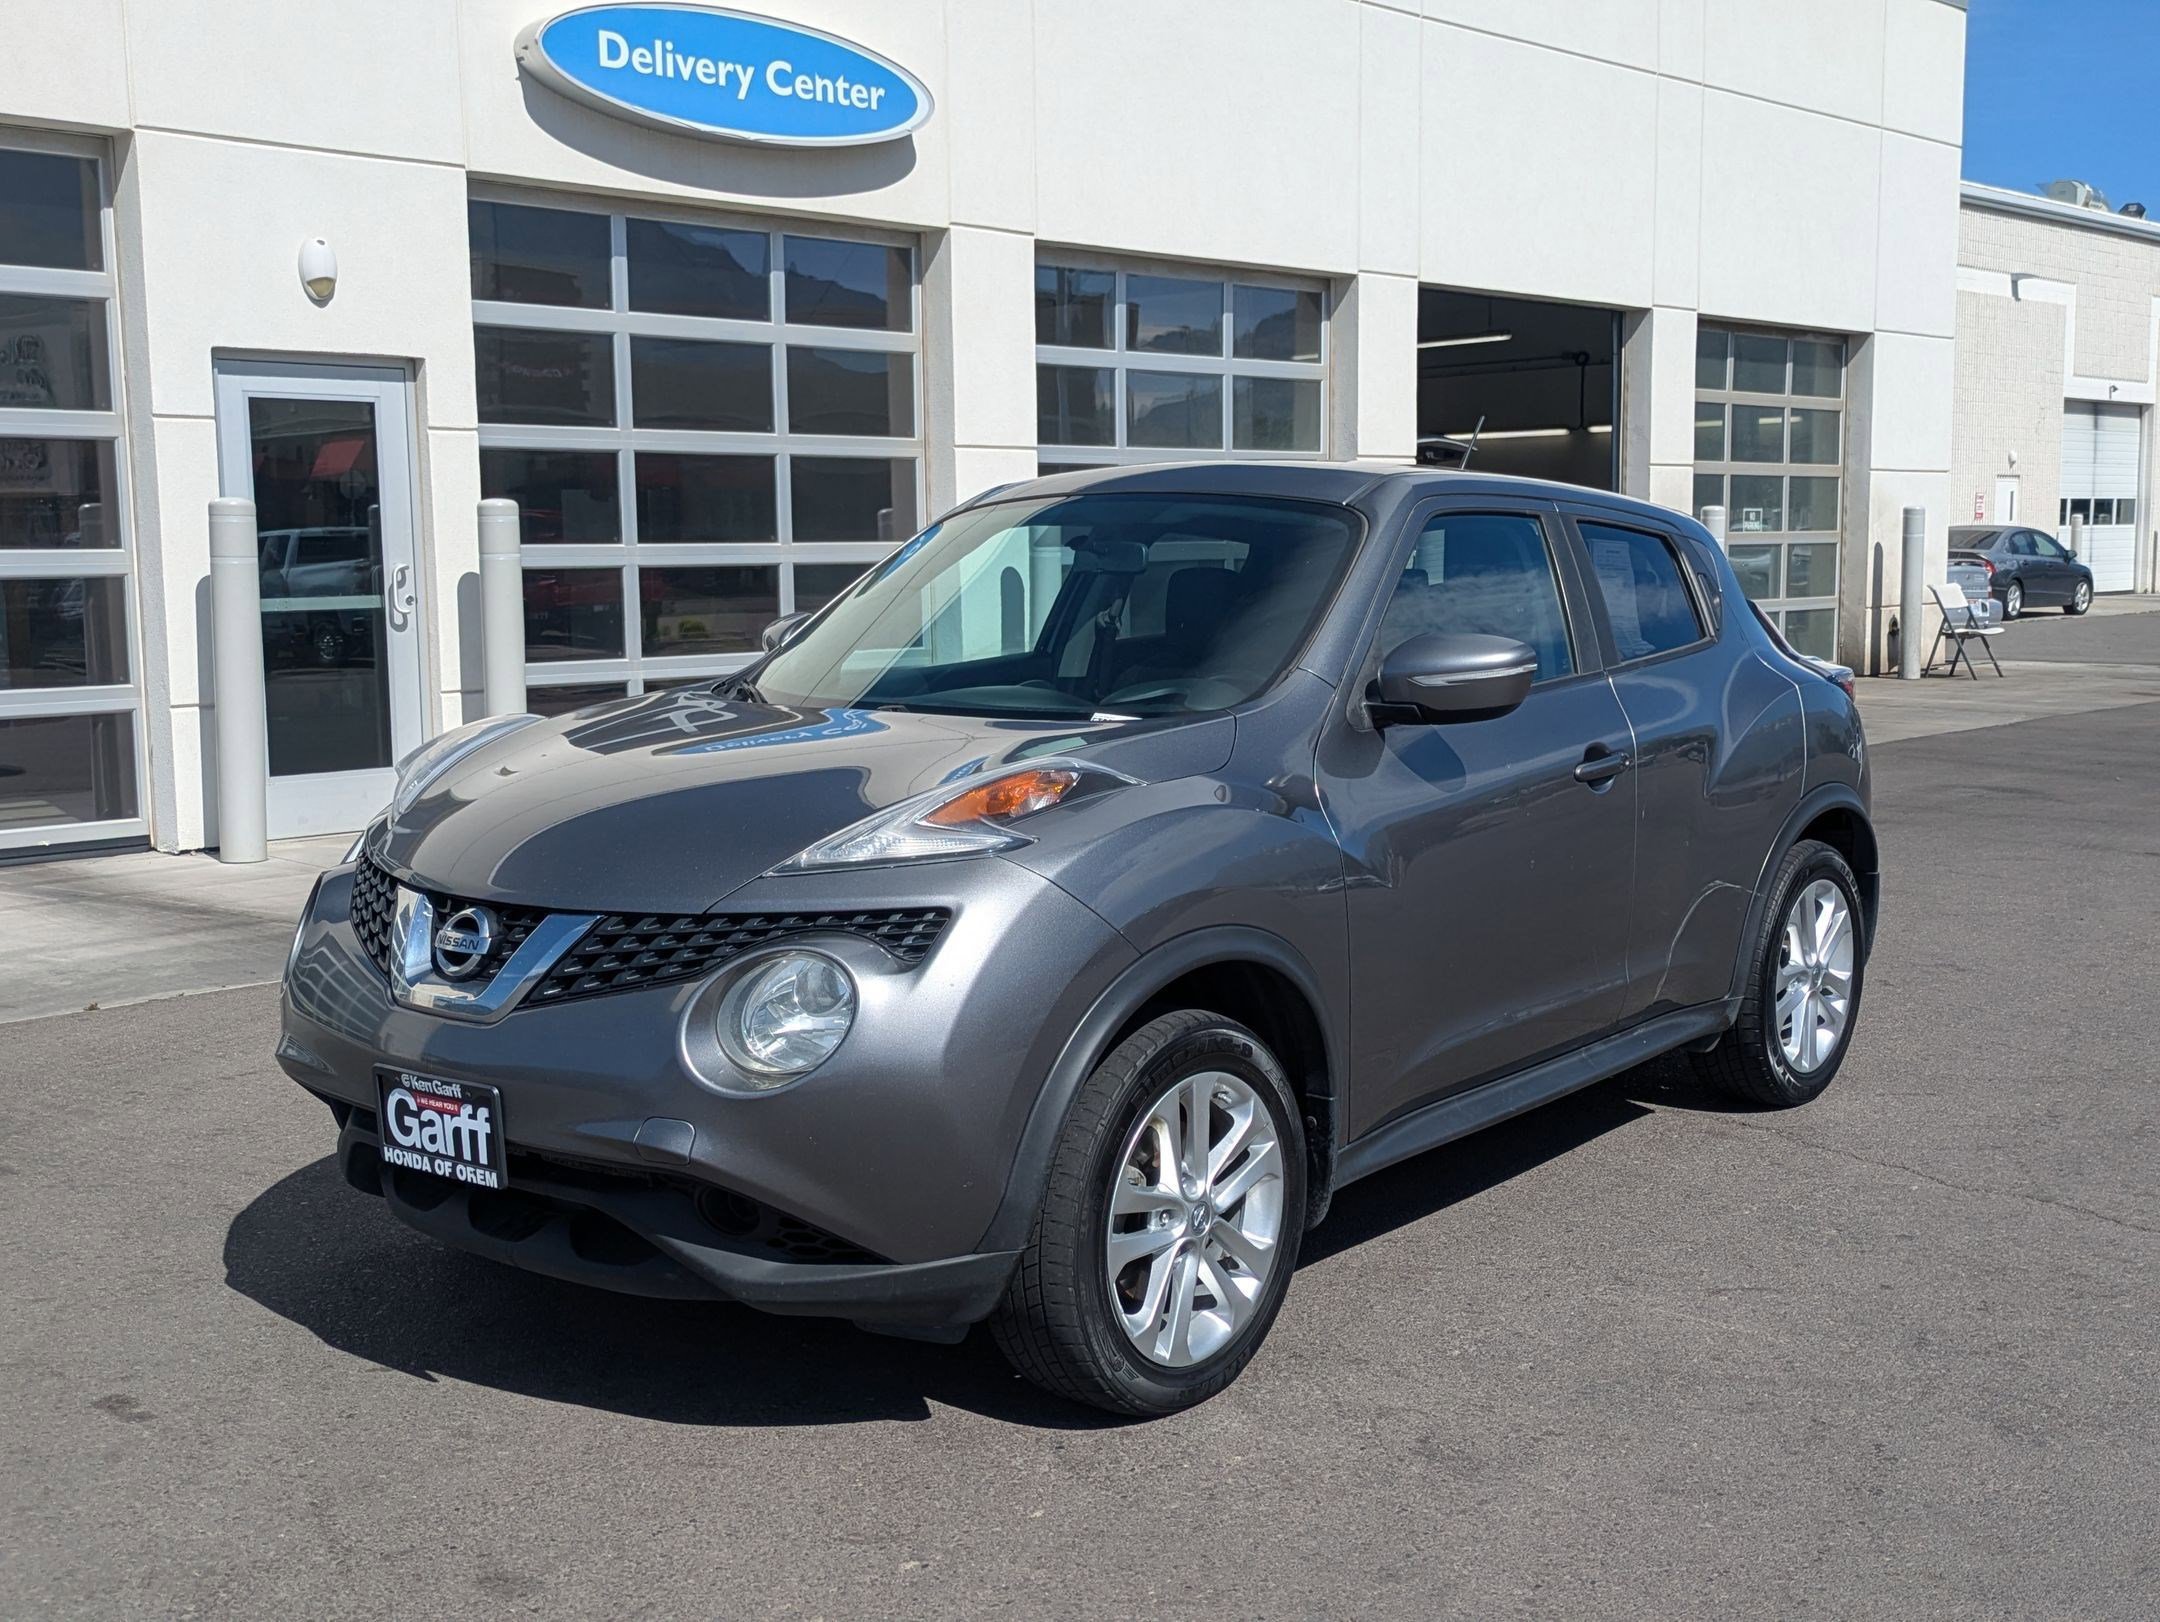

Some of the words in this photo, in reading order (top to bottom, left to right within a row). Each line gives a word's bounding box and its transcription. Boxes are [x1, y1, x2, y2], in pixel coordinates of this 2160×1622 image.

[598, 29, 755, 100] Delivery
[765, 60, 886, 111] Center
[438, 933, 480, 950] NISSAN
[410, 1075, 433, 1093] Ken
[432, 1080, 462, 1098] Garff
[387, 1088, 491, 1165] Garff
[384, 1146, 432, 1173] HONDA
[434, 1159, 453, 1177] OF
[456, 1164, 498, 1189] OREM
